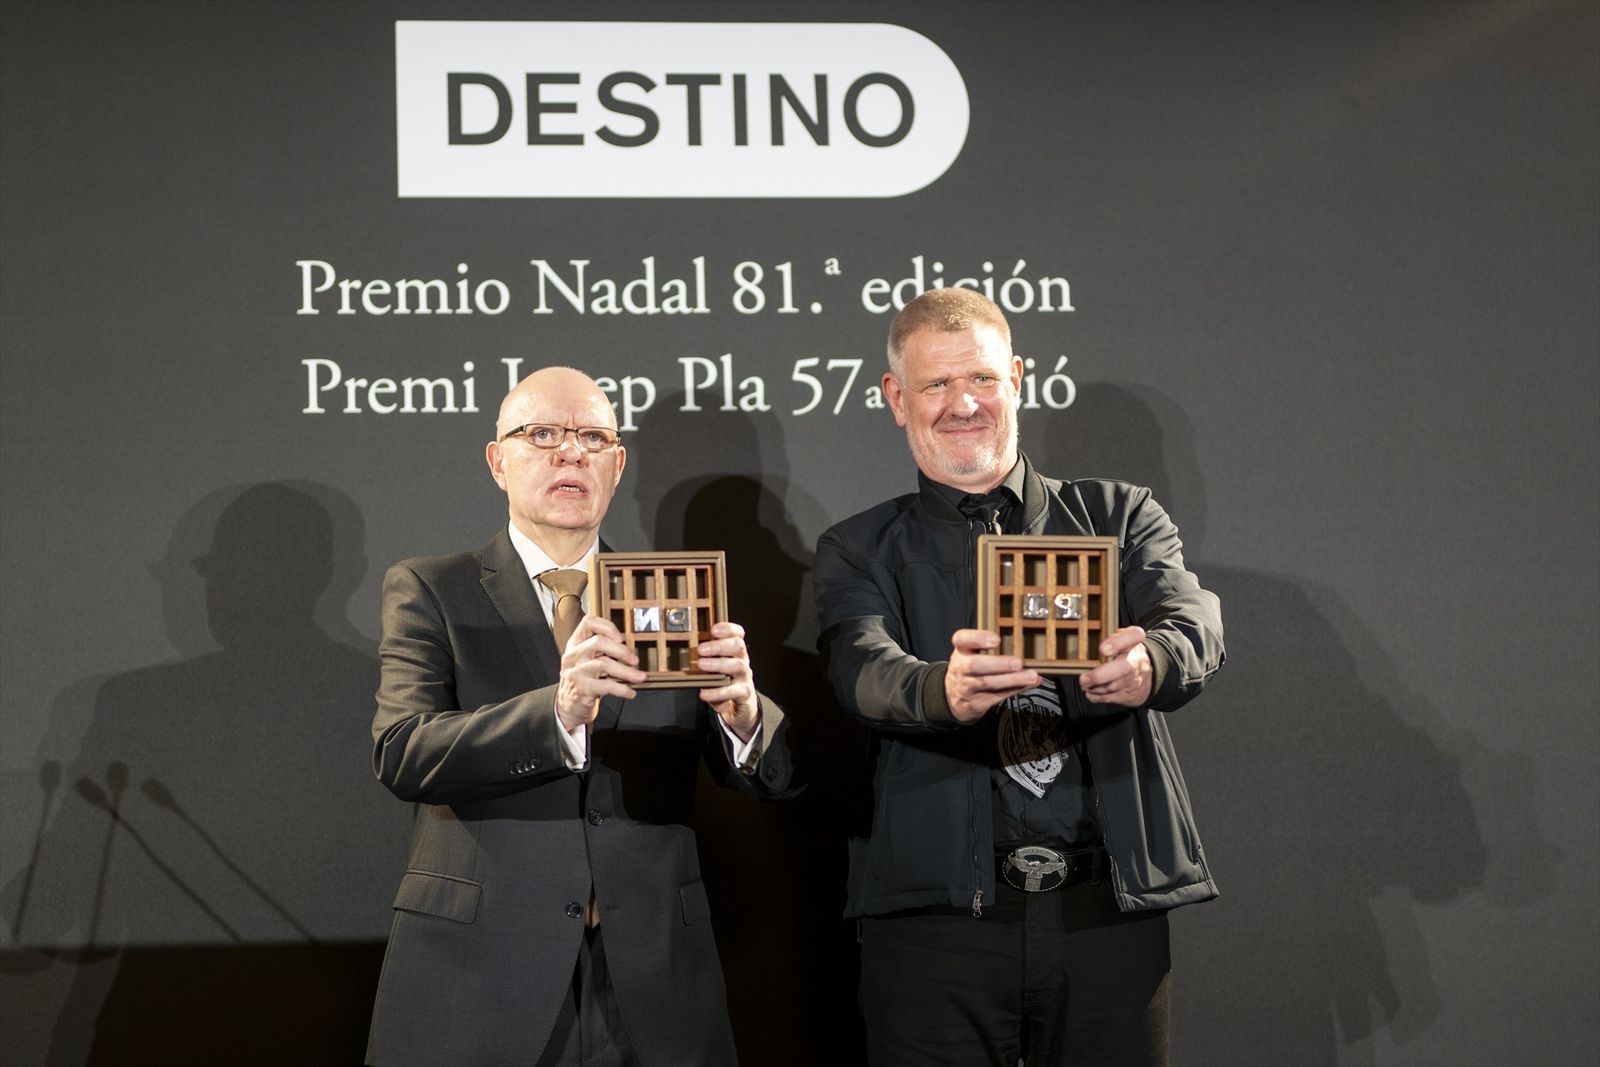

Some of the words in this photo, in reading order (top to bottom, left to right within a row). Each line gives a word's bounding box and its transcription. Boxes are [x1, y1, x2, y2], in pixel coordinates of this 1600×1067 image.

[447, 71, 915, 148] DESTINO
[295, 259, 511, 316] Premio
[530, 255, 712, 316] Nadal
[301, 358, 480, 415] Premi
[677, 352, 772, 412] Pla
